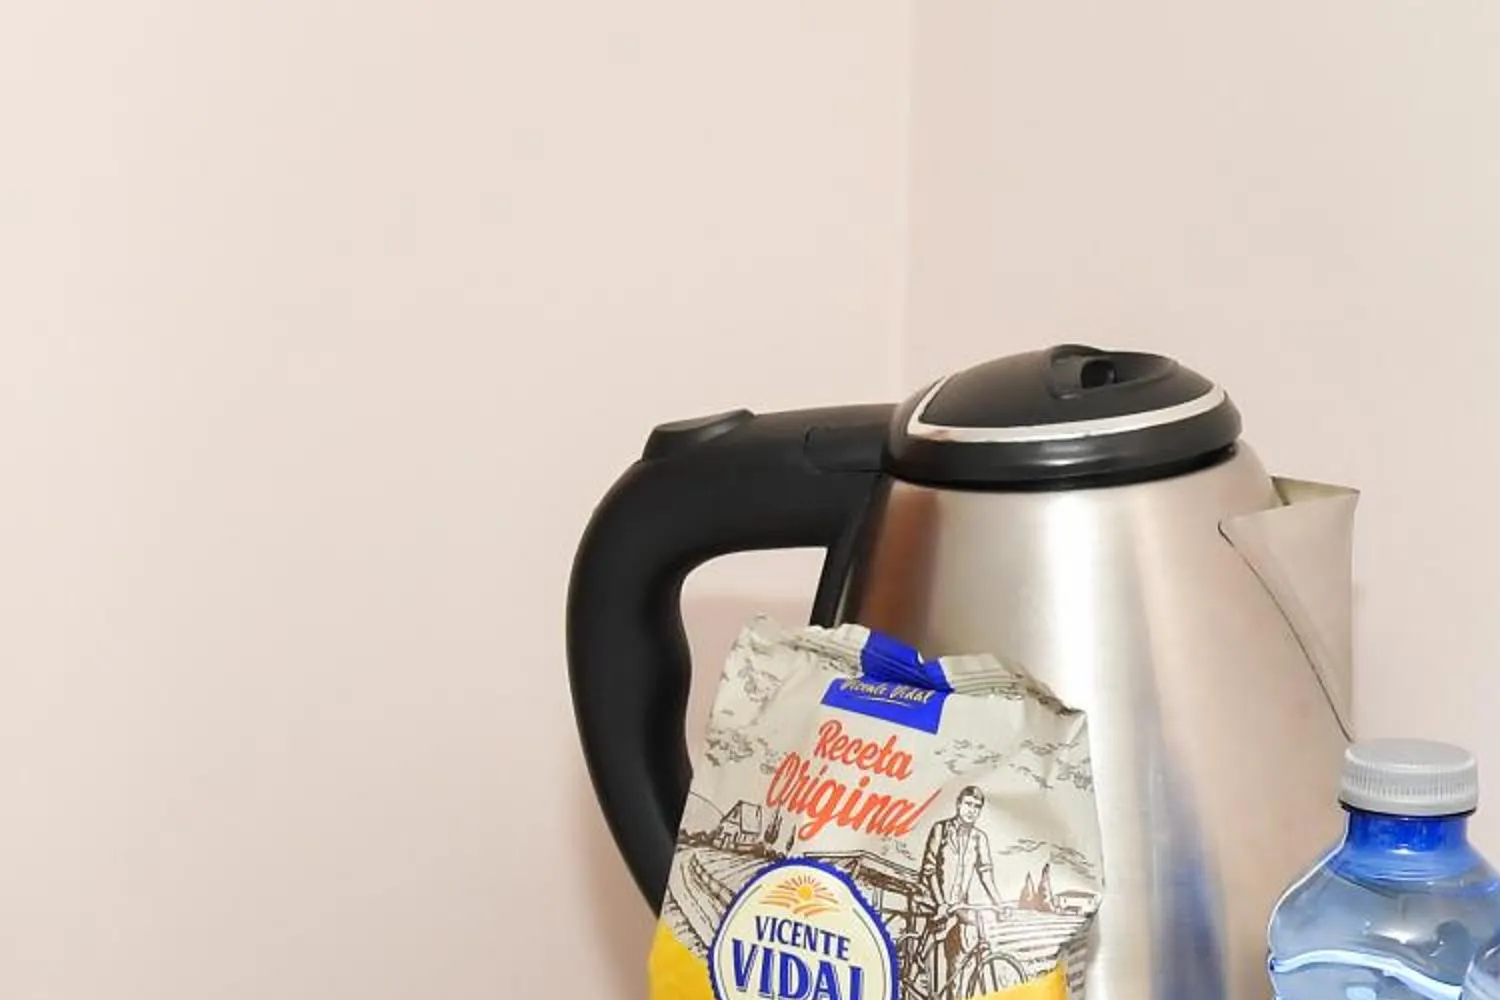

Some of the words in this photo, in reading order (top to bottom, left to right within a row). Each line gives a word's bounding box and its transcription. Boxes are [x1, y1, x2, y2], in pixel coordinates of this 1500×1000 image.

[813, 719, 913, 782] Receta
[765, 751, 942, 842] Original
[755, 915, 852, 961] VICENTE
